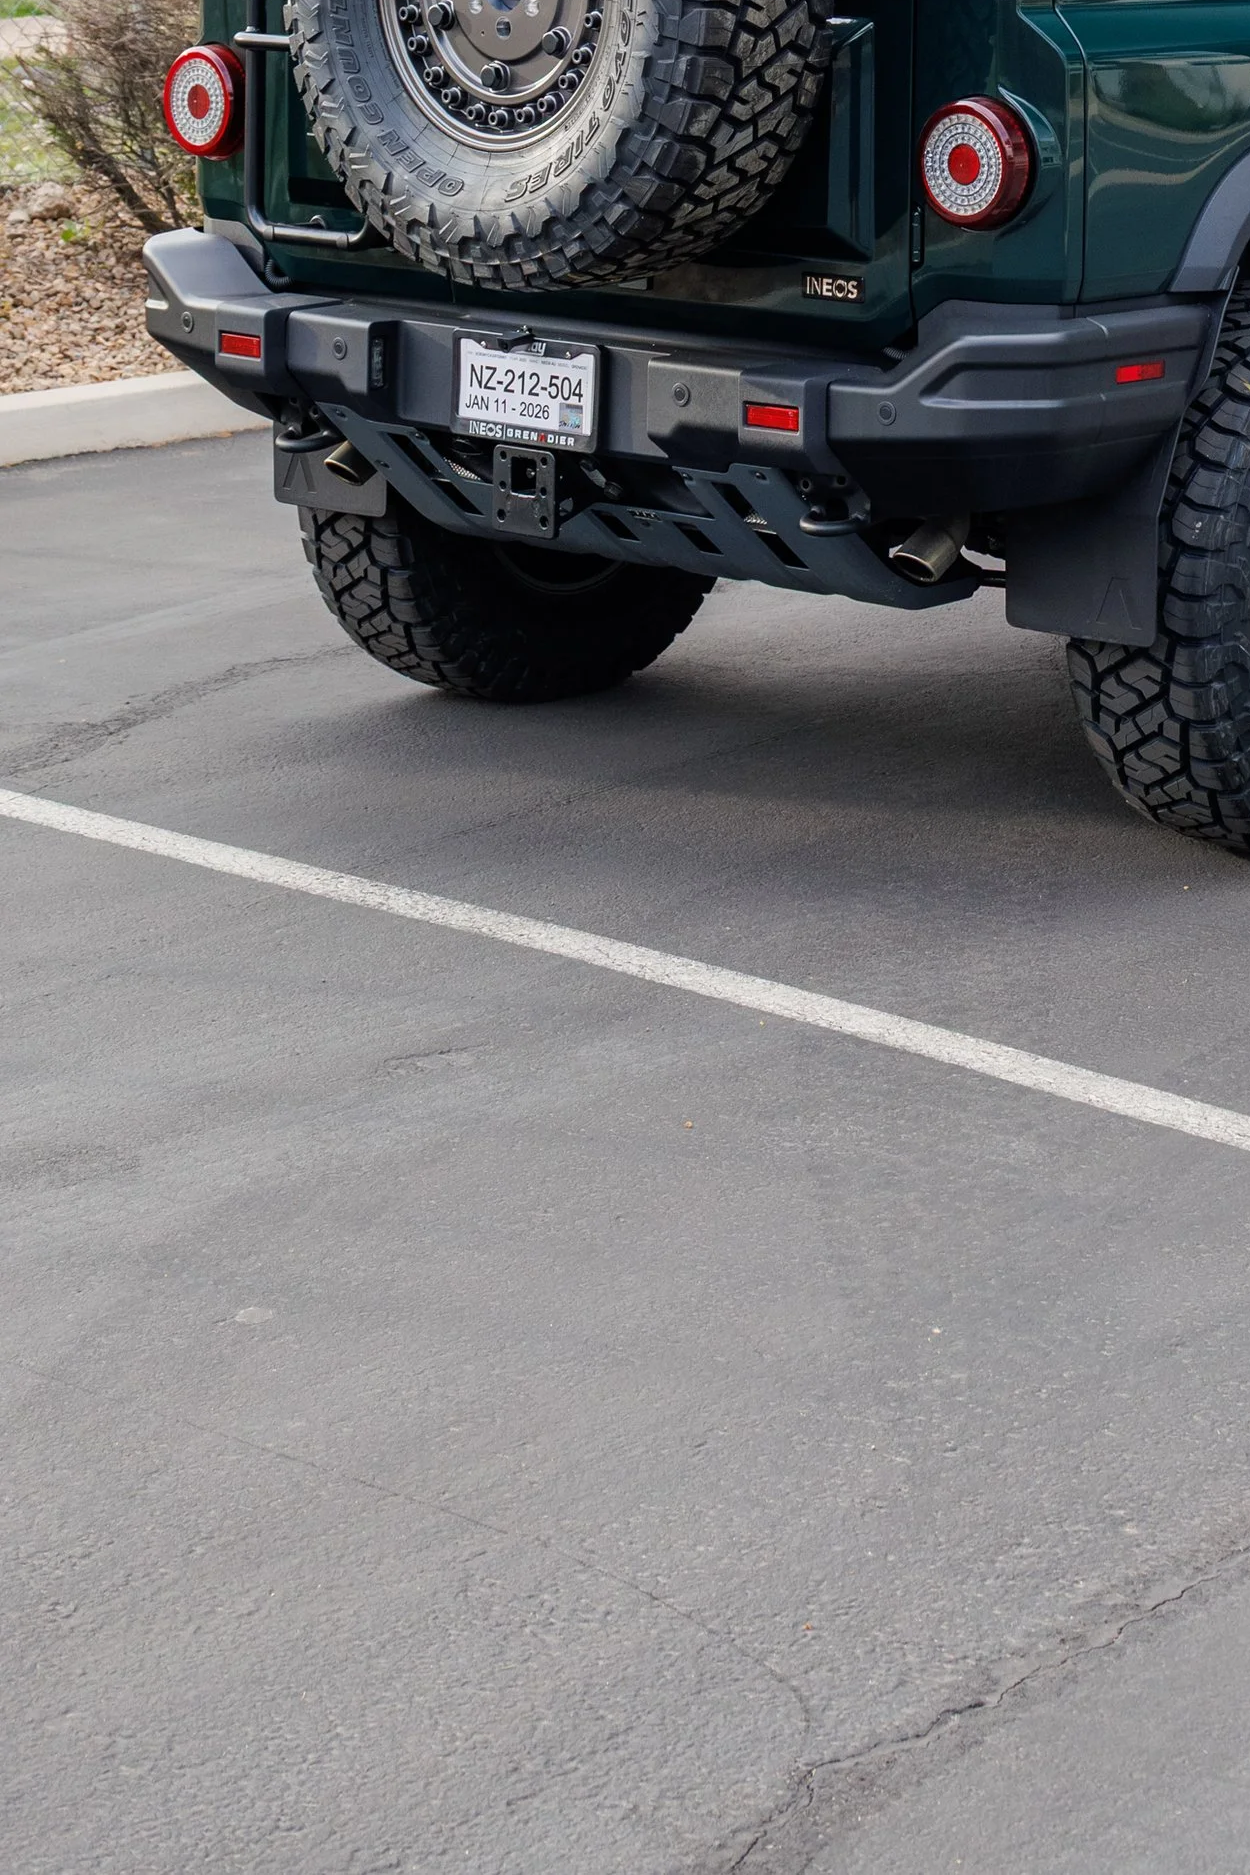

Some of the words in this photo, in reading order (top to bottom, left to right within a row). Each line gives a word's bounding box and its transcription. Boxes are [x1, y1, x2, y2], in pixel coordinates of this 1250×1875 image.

[376, 128, 465, 197] OPEN
[504, 111, 600, 203] TIRES
[806, 276, 858, 299] INEOS
[470, 363, 583, 403] NZ-212-504
[465, 394, 489, 411] JAN
[494, 397, 507, 413] 11
[520, 401, 550, 420] 2026
[469, 420, 503, 438] INEOS
[506, 427, 575, 447] GRENADIER
